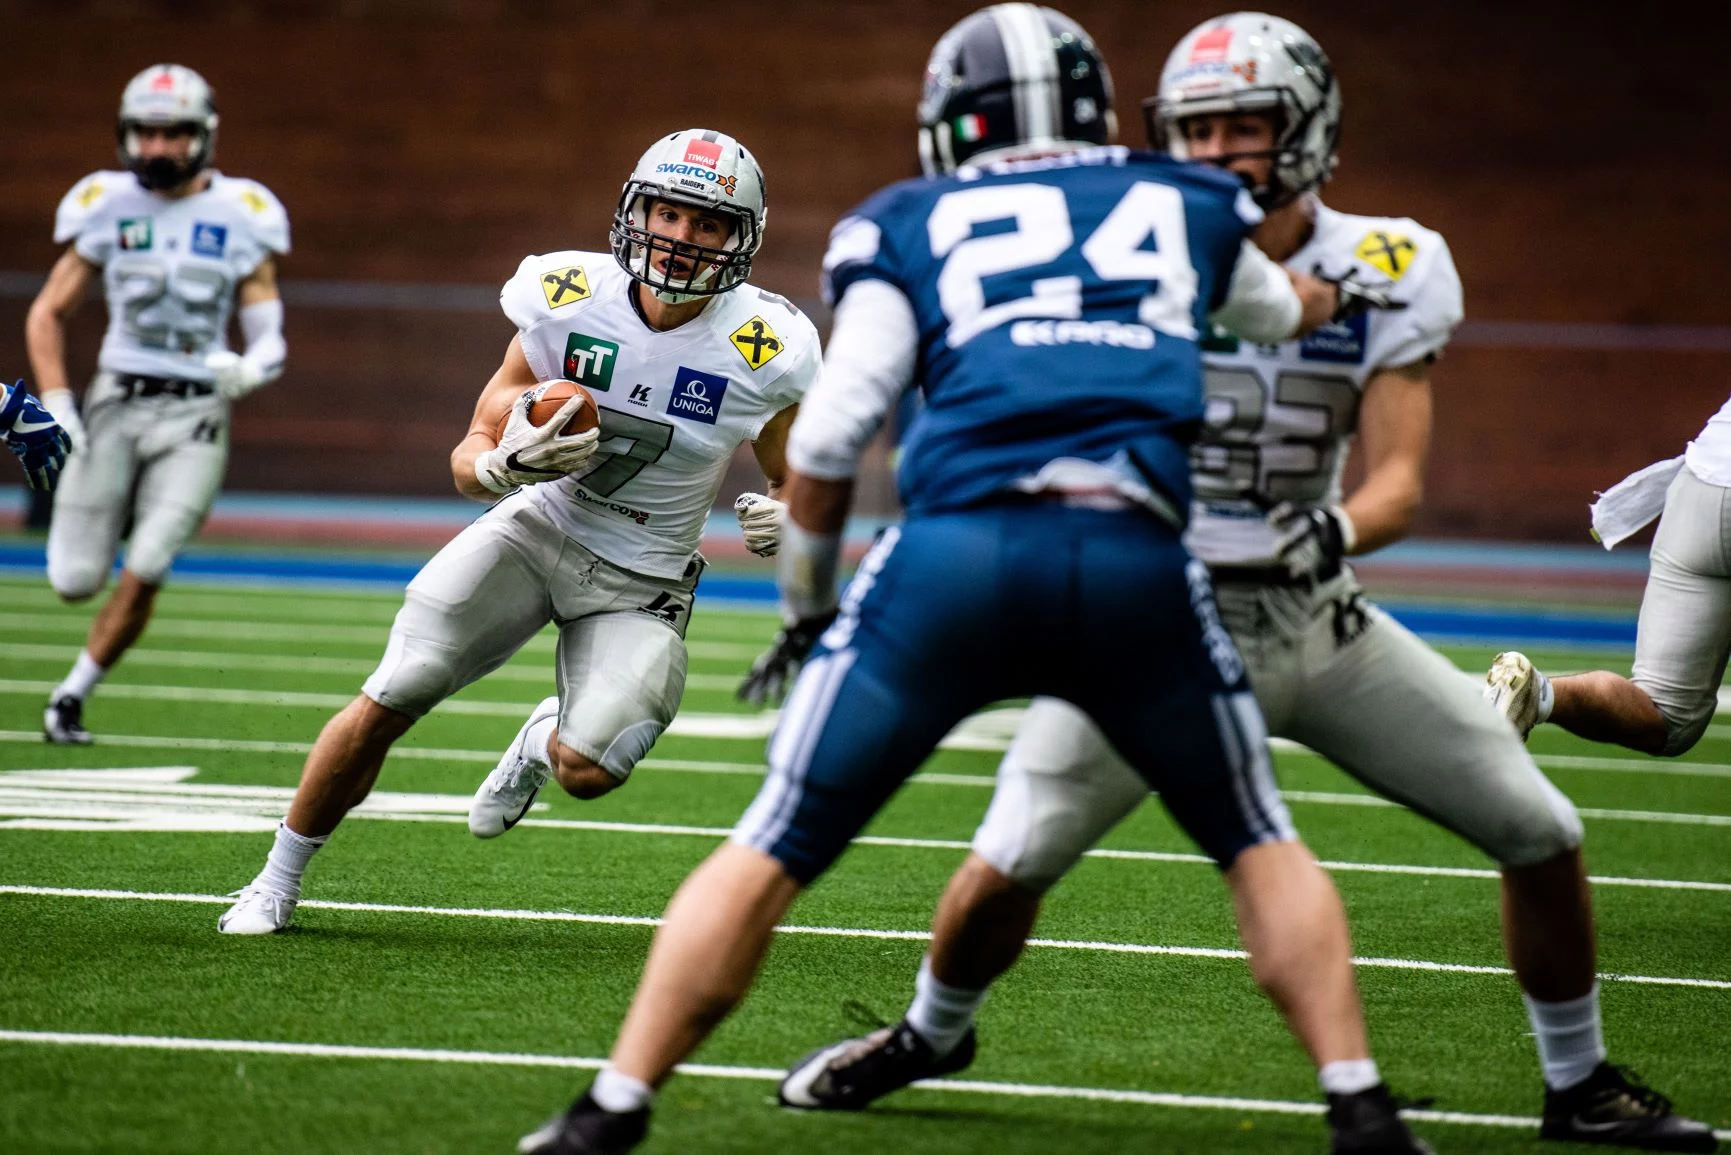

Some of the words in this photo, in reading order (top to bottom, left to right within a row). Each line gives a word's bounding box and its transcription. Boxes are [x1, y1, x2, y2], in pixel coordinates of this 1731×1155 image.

[656, 163, 717, 182] swarco
[926, 180, 1199, 349] 24
[672, 397, 714, 417] UNIQA
